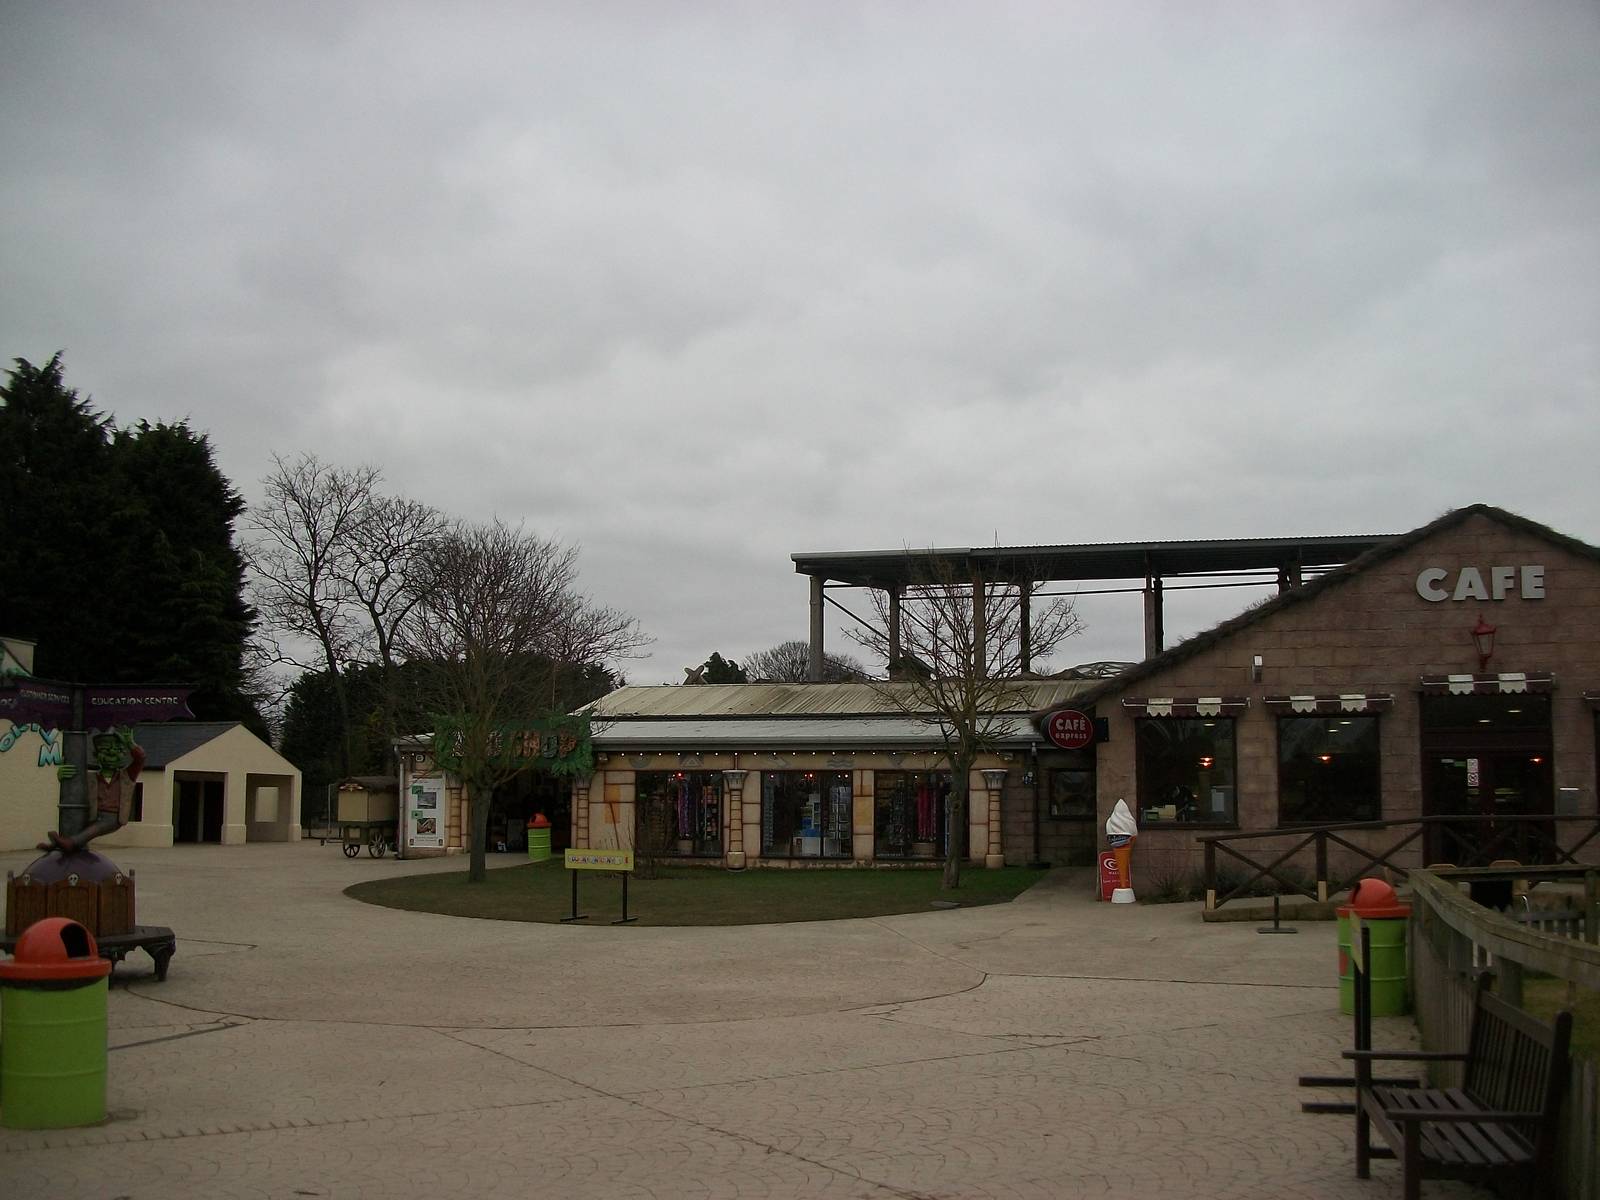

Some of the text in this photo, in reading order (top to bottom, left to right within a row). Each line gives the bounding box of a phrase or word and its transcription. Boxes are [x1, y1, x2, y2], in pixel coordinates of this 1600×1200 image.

[1416, 565, 1545, 601] CAFE
[92, 696, 179, 706] EDUCATION CENTRE
